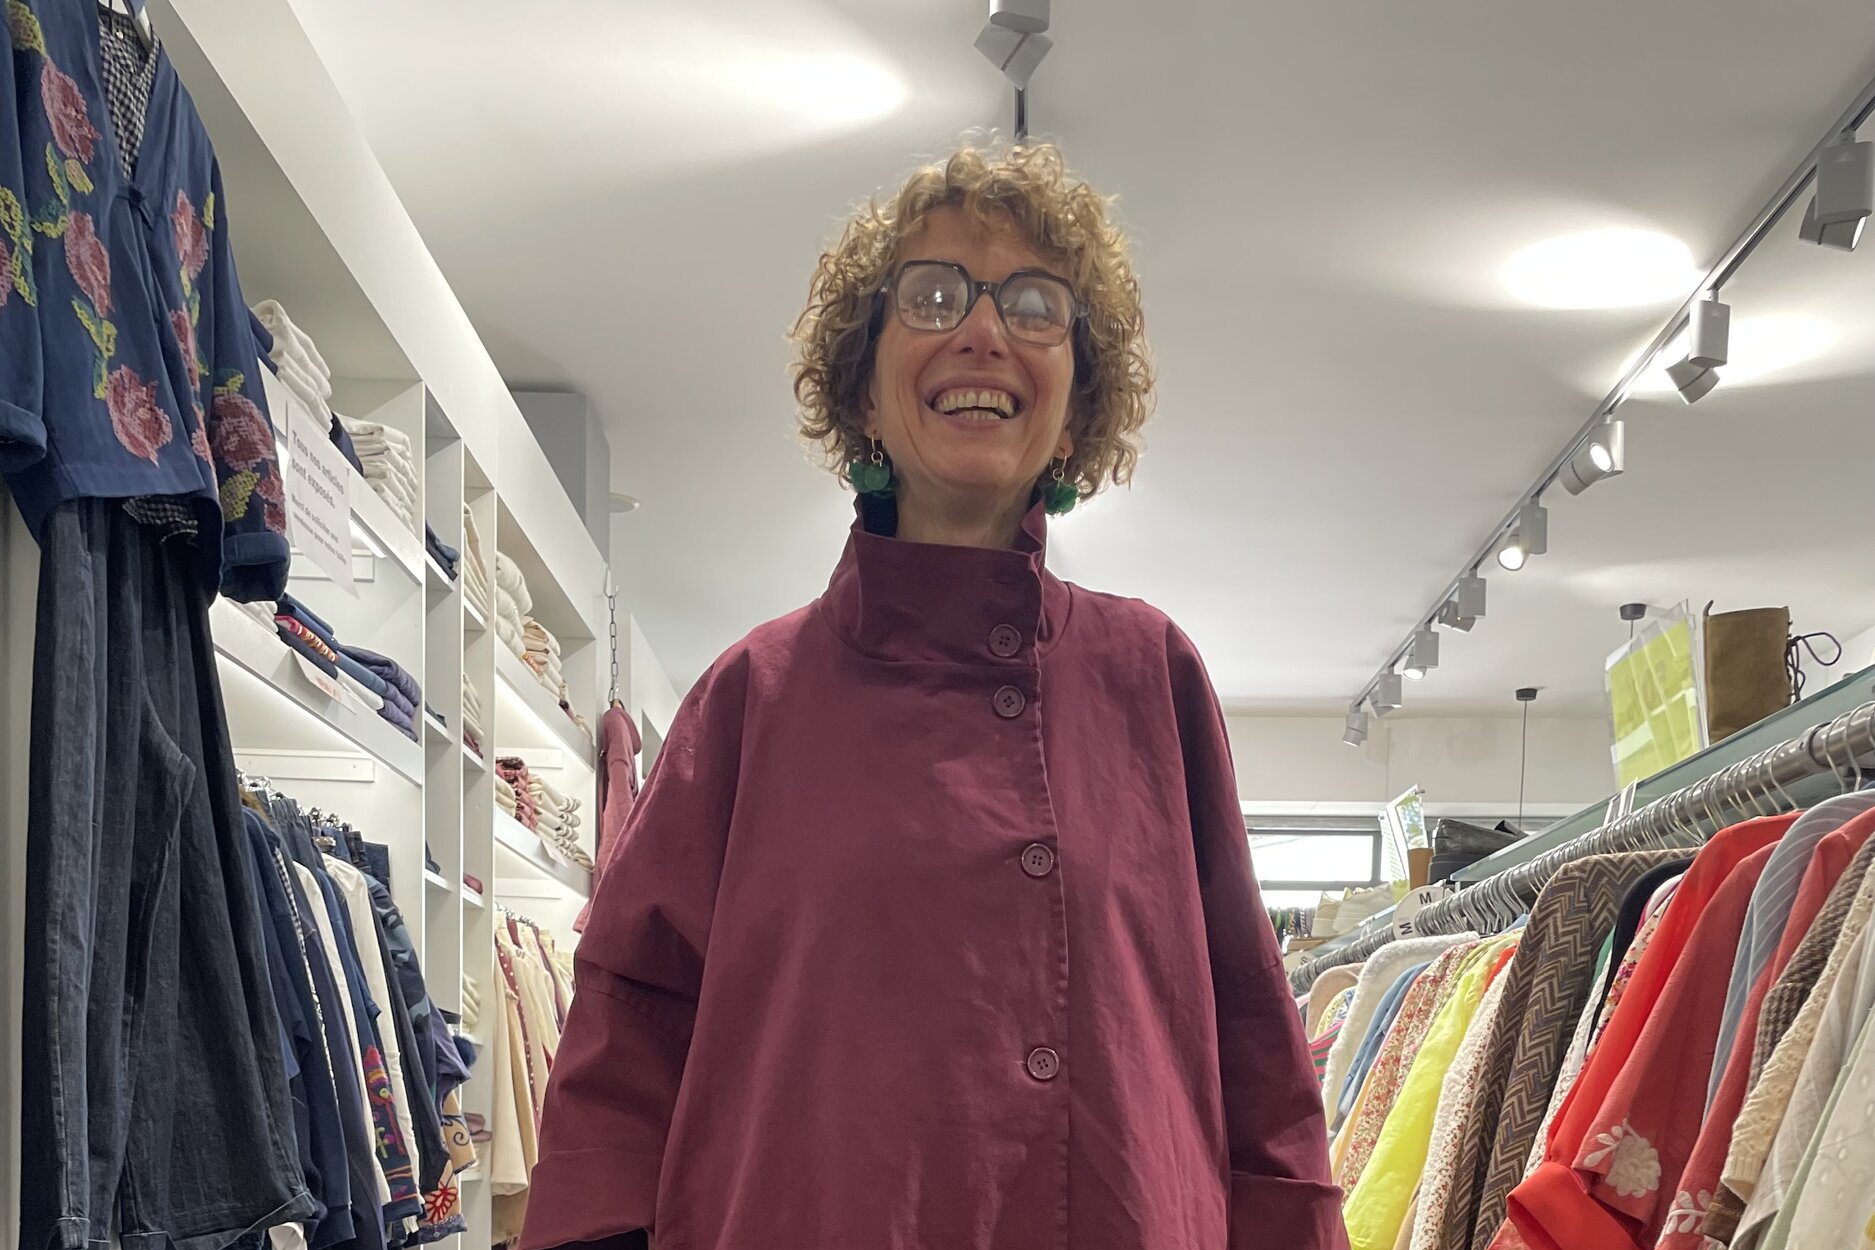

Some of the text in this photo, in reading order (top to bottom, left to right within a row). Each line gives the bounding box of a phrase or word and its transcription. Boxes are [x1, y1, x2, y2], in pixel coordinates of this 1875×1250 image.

[292, 430, 344, 495] Tous nos articles
[292, 458, 306, 480] sont
[1419, 891, 1432, 905] M
